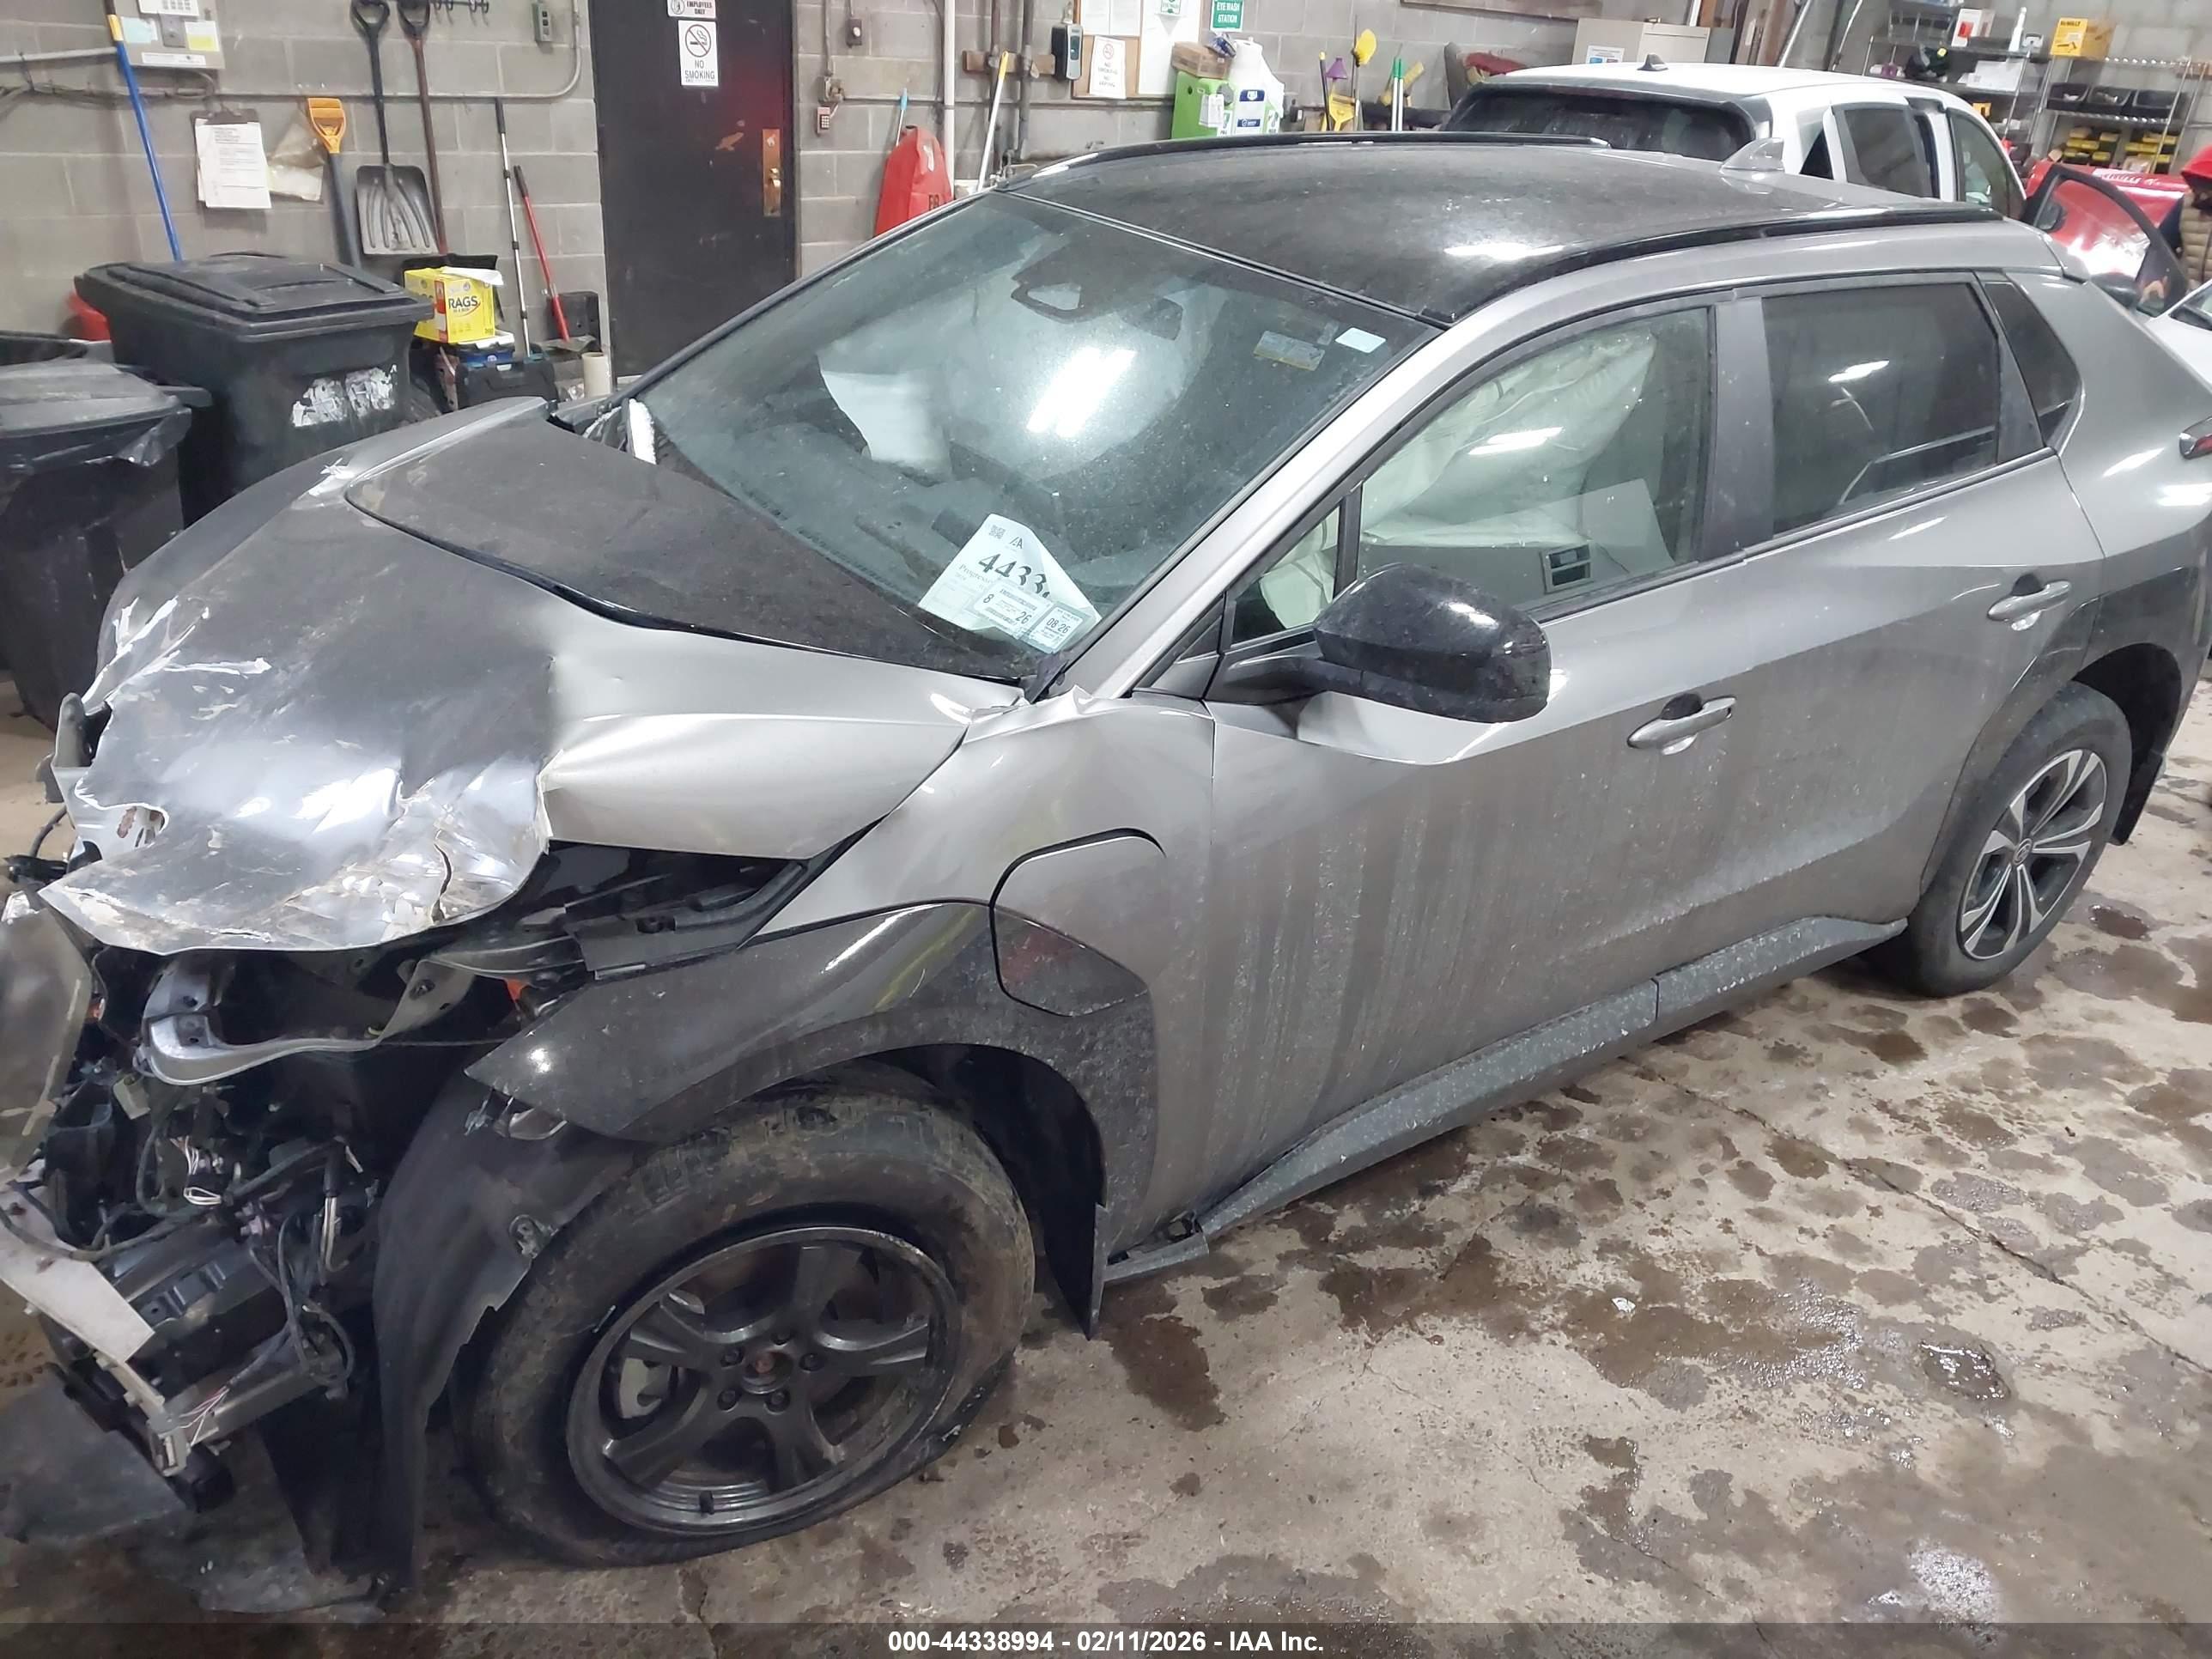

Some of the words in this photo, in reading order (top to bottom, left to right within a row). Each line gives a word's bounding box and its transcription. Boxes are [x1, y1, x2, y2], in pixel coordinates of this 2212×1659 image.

[1218, 14, 1237, 23] STATION
[694, 59, 705, 69] NO
[684, 70, 715, 80] SMOKING
[448, 295, 478, 309] RAGS
[982, 593, 995, 604] 8
[1016, 611, 1032, 624] 26
